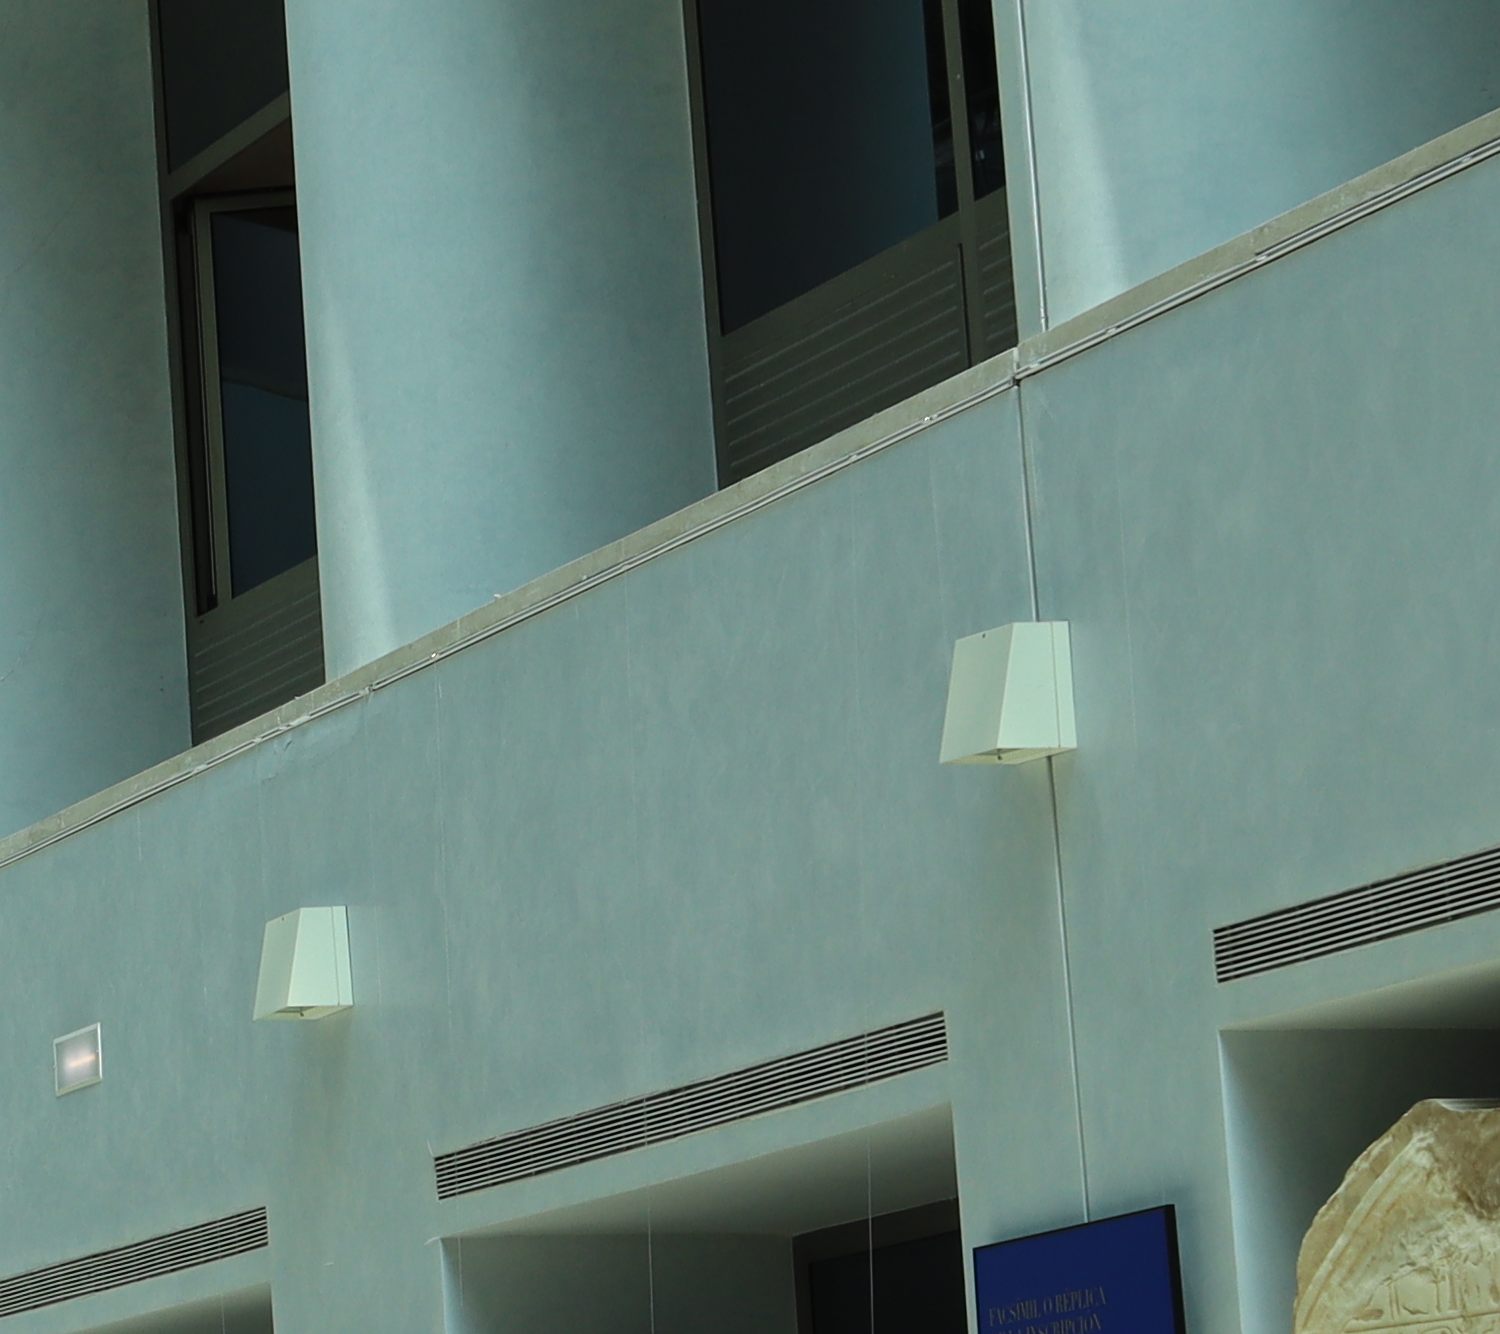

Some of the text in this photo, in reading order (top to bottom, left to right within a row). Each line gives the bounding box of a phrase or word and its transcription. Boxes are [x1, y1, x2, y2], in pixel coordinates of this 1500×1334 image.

[989, 1286, 1107, 1327] FACSÍMIL O RÉPLICA
